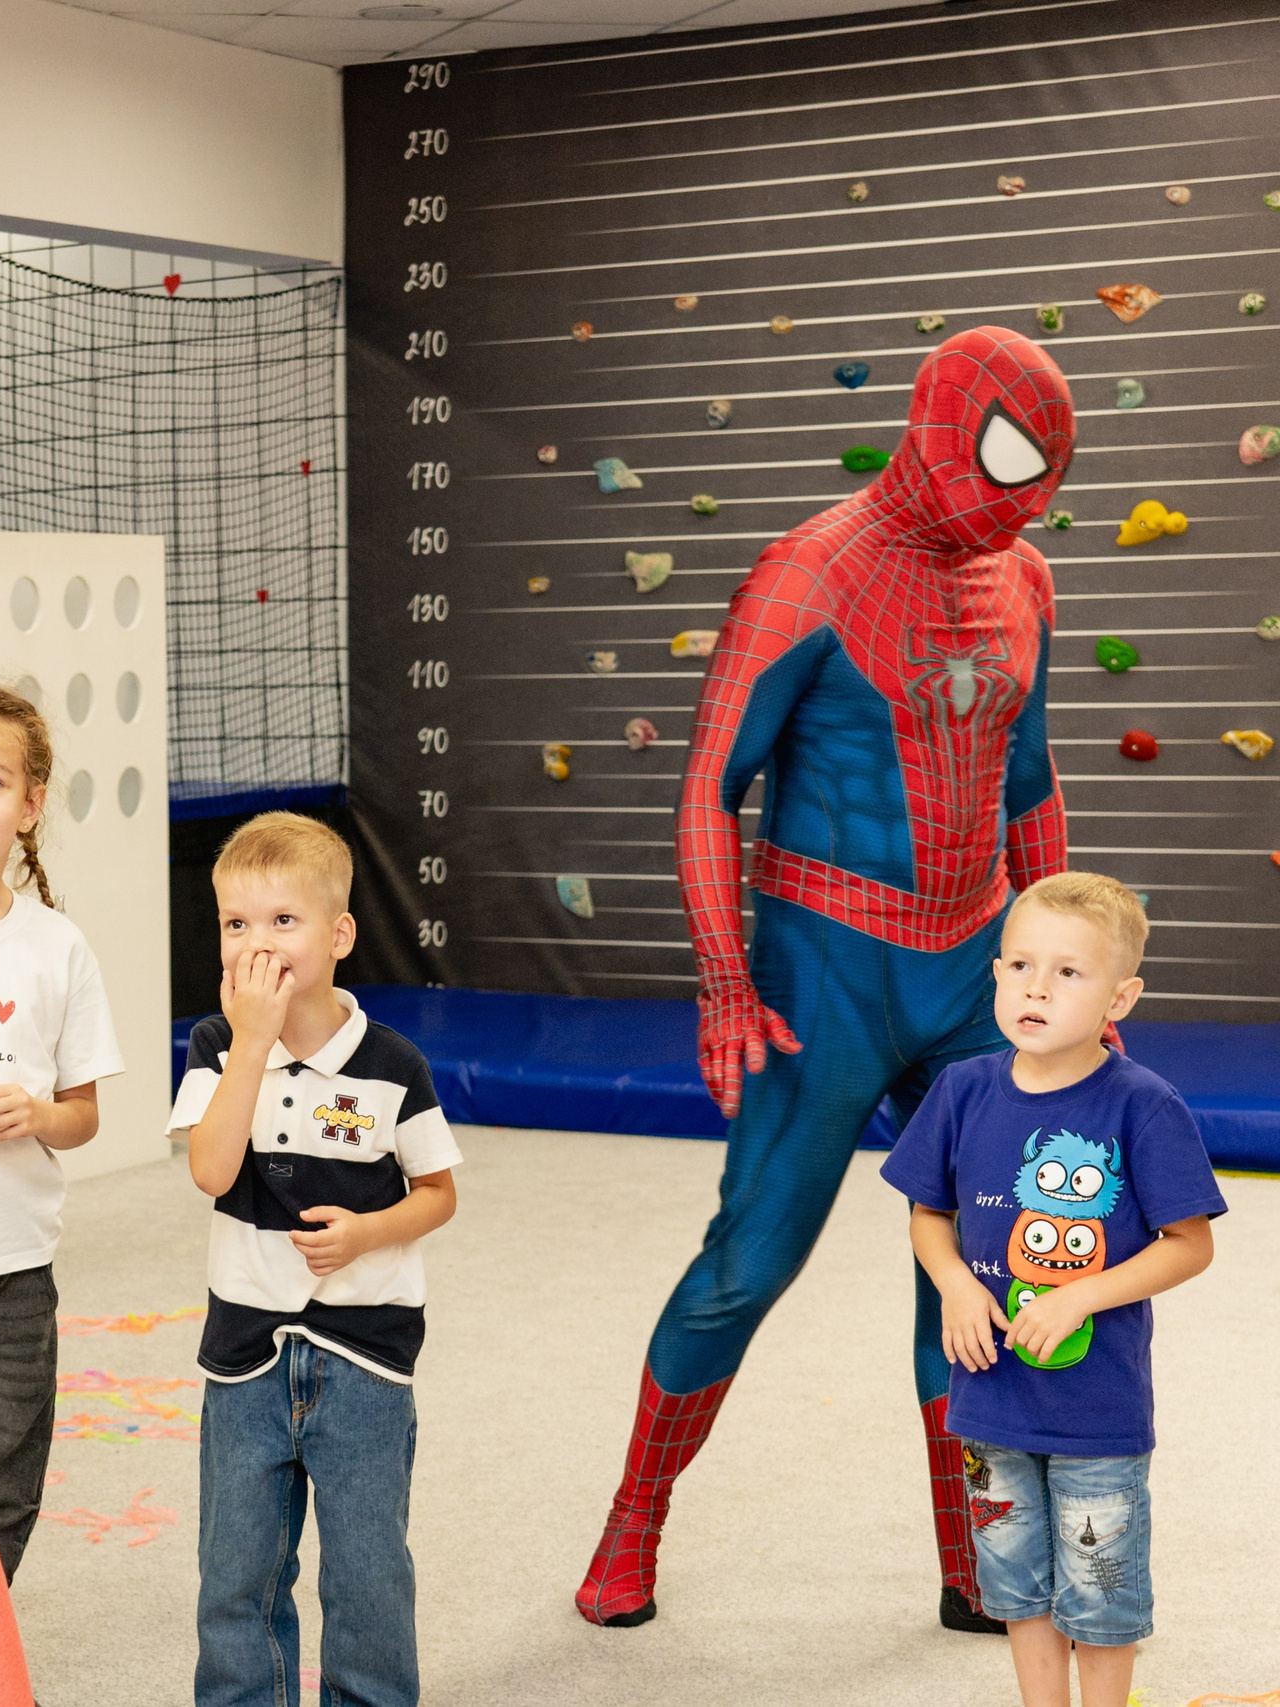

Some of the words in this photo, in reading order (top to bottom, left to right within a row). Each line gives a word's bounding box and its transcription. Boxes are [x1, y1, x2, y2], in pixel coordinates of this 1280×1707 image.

[404, 62, 450, 93] 290
[404, 128, 449, 160] 270
[404, 195, 447, 226] 250
[404, 262, 447, 292] 230
[405, 330, 448, 361] 210
[406, 396, 452, 425] 190
[406, 462, 450, 491] 170
[407, 527, 449, 556] 150
[407, 594, 449, 623] 130
[407, 660, 450, 689] 110
[418, 727, 449, 754] 90
[418, 790, 449, 818] 70
[419, 856, 447, 884] 50
[419, 919, 448, 947] 30
